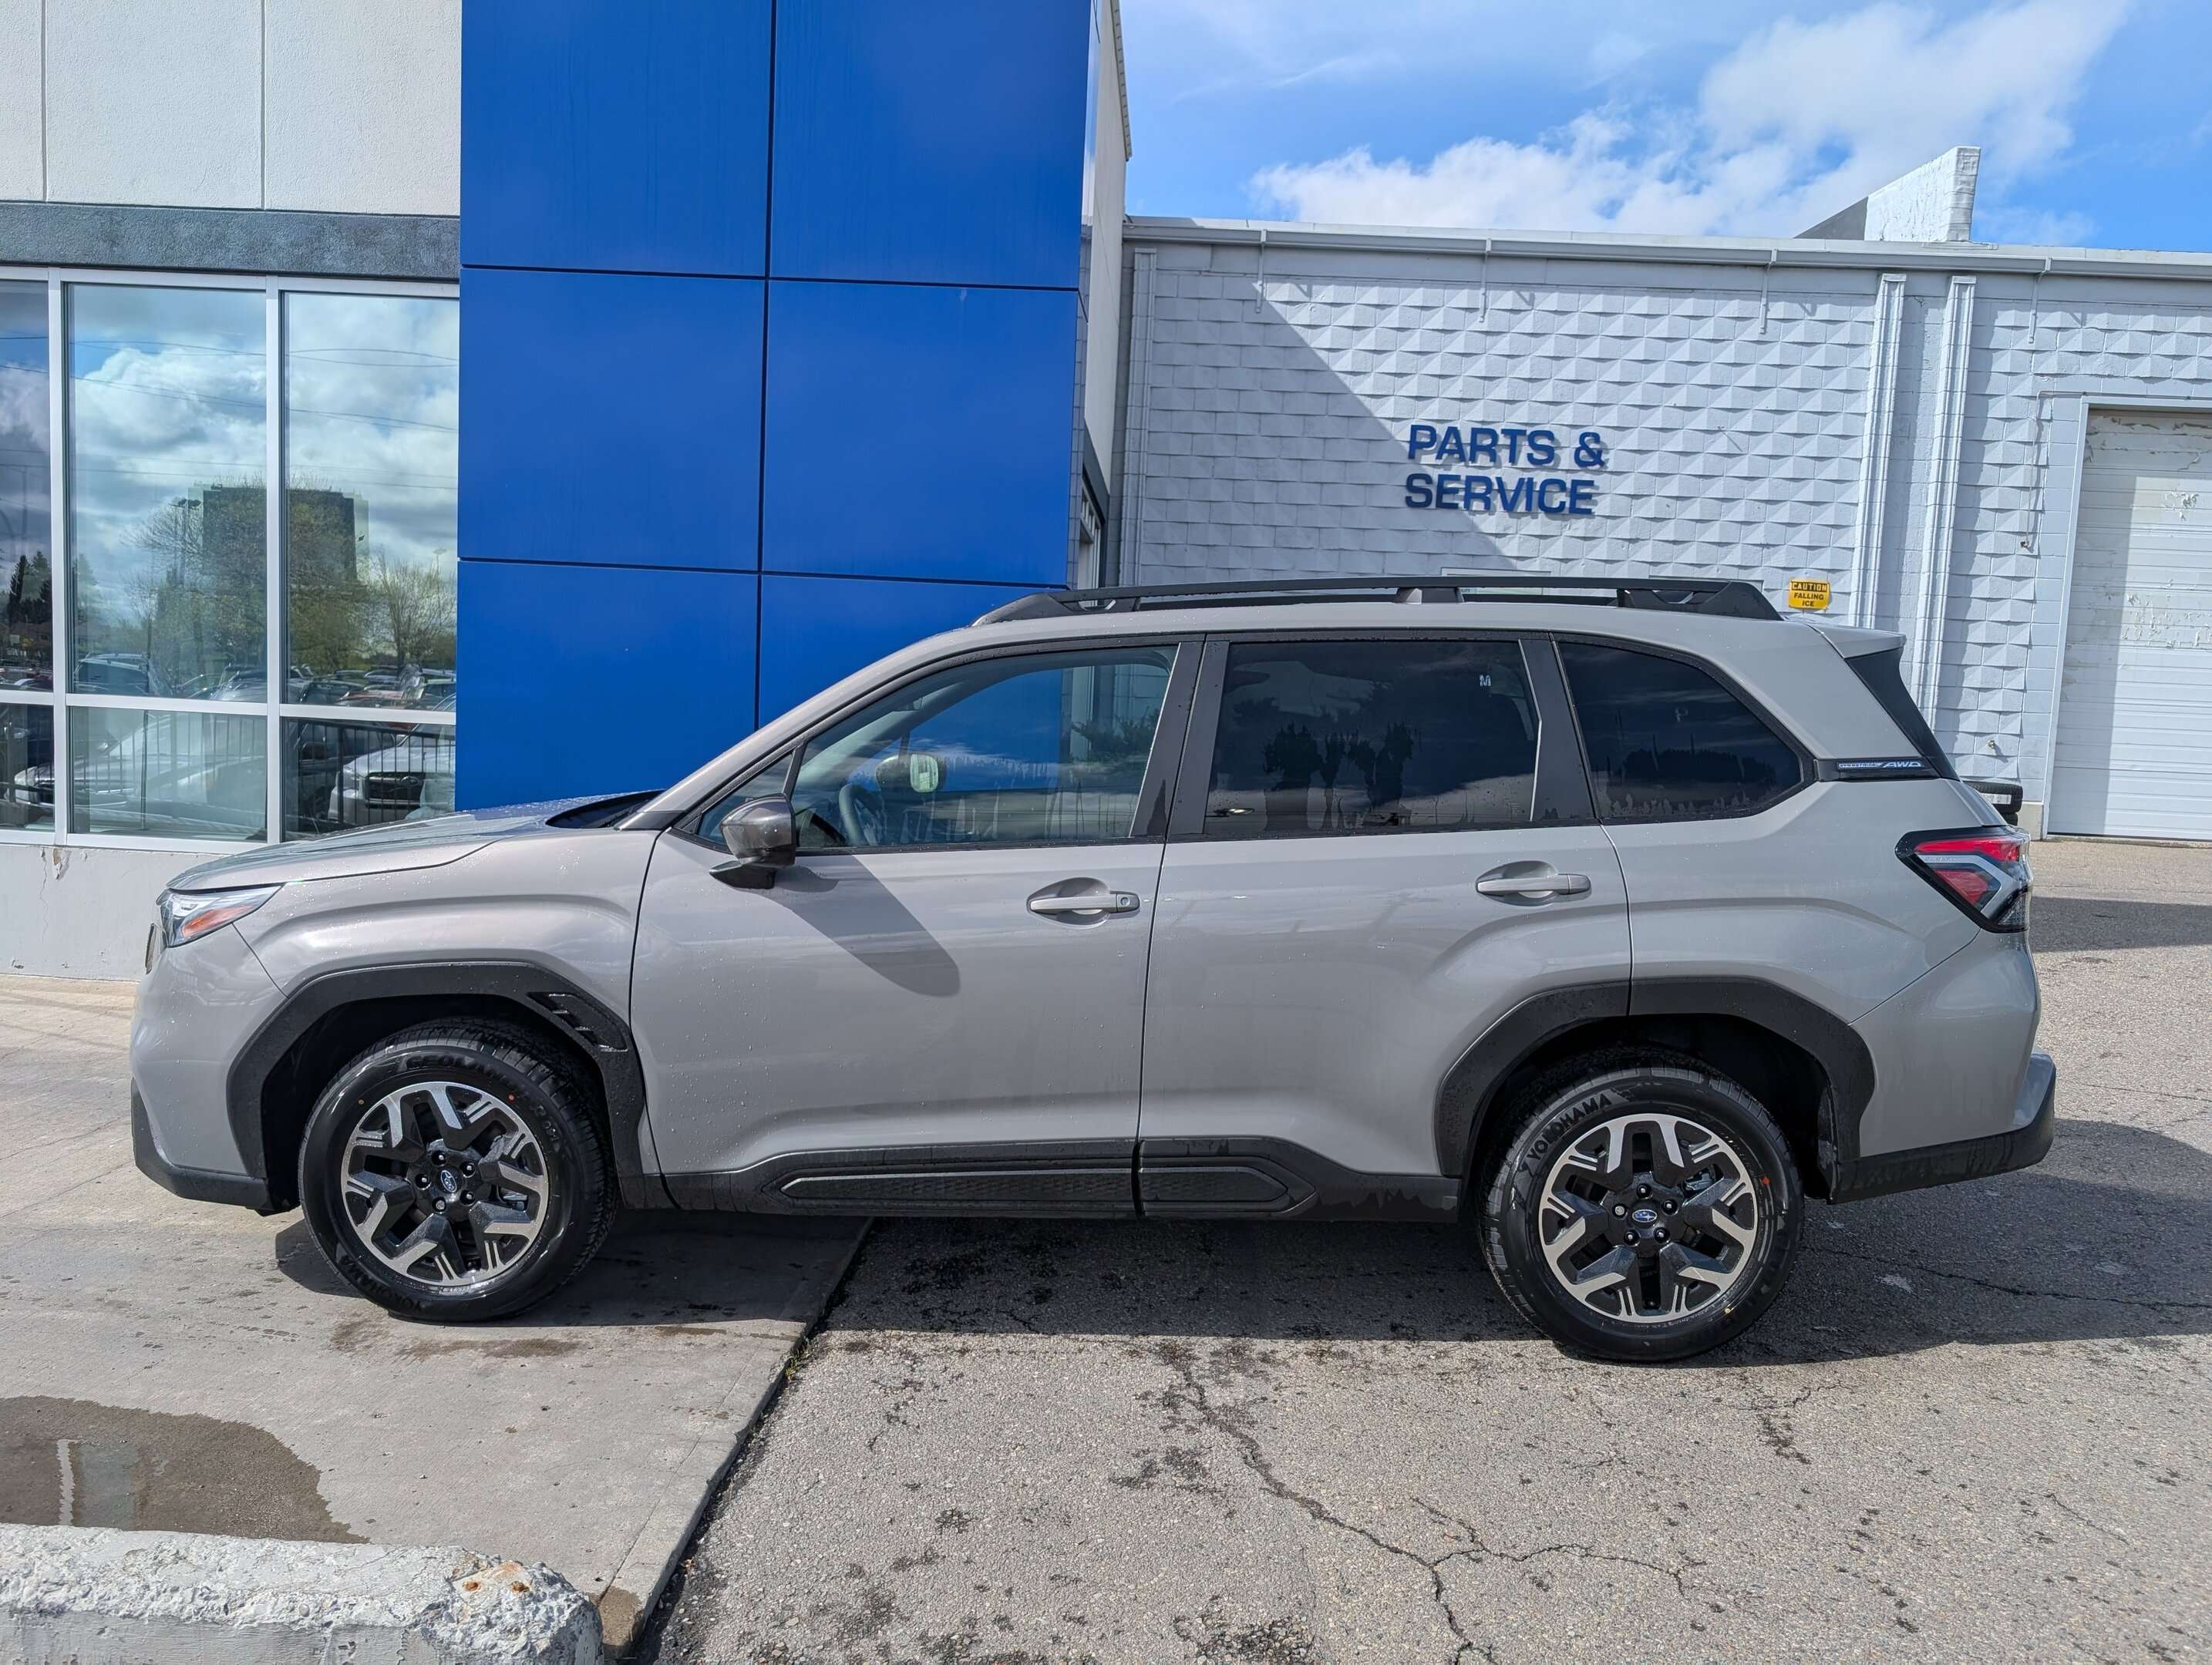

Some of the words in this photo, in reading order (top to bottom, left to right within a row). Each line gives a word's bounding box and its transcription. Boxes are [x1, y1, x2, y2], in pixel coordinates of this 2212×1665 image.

[1408, 425, 1555, 466] PARTS
[1574, 432, 1605, 467] &
[1405, 473, 1594, 514] SERVICE
[1793, 583, 1826, 591] CAUTION
[1882, 760, 1922, 769] AWD
[1527, 1093, 1612, 1161] YOKOHAMA
